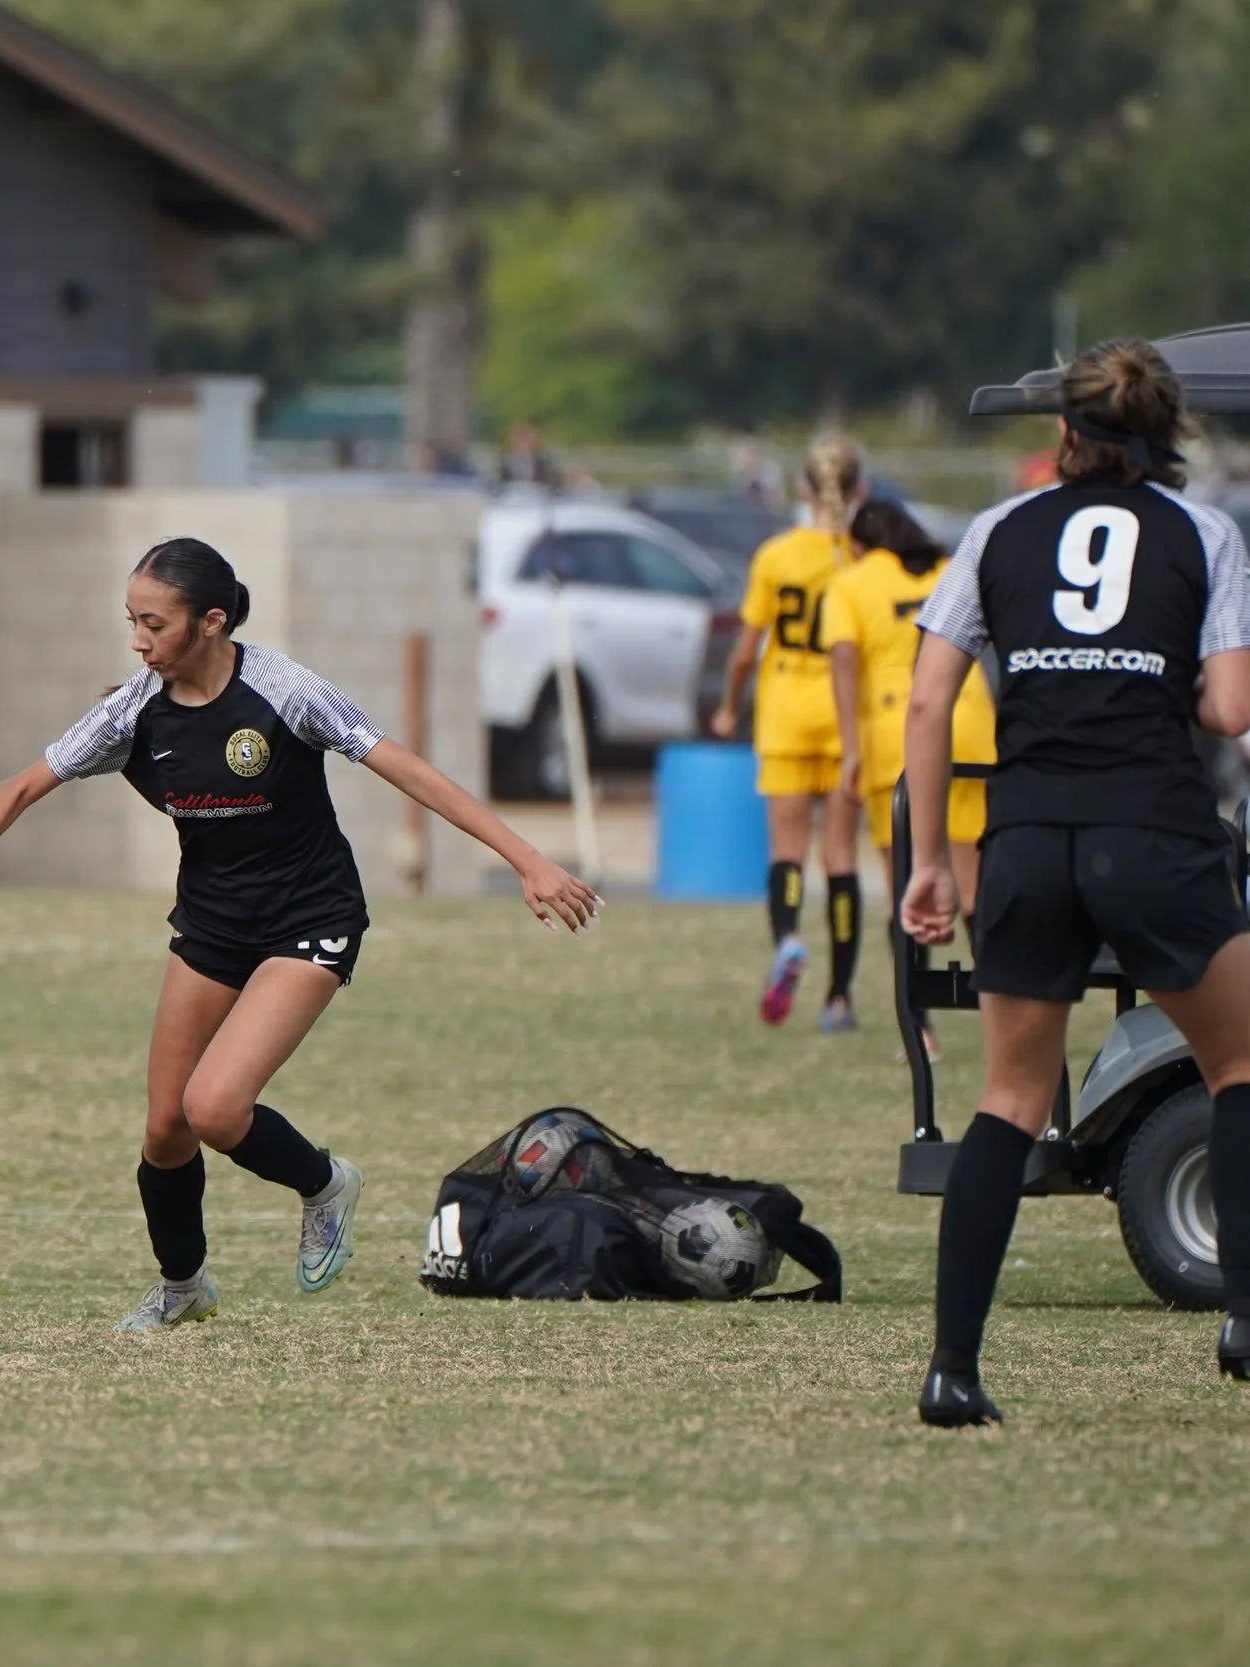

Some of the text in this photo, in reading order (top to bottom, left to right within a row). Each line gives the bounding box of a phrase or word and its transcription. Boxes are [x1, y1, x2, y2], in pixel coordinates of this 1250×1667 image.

[1052, 504, 1140, 636] 9
[247, 731, 264, 745] ELITE
[229, 755, 269, 776] FOOTBALL CLUB
[165, 791, 266, 808] California
[165, 802, 274, 819] TRANSMISSION
